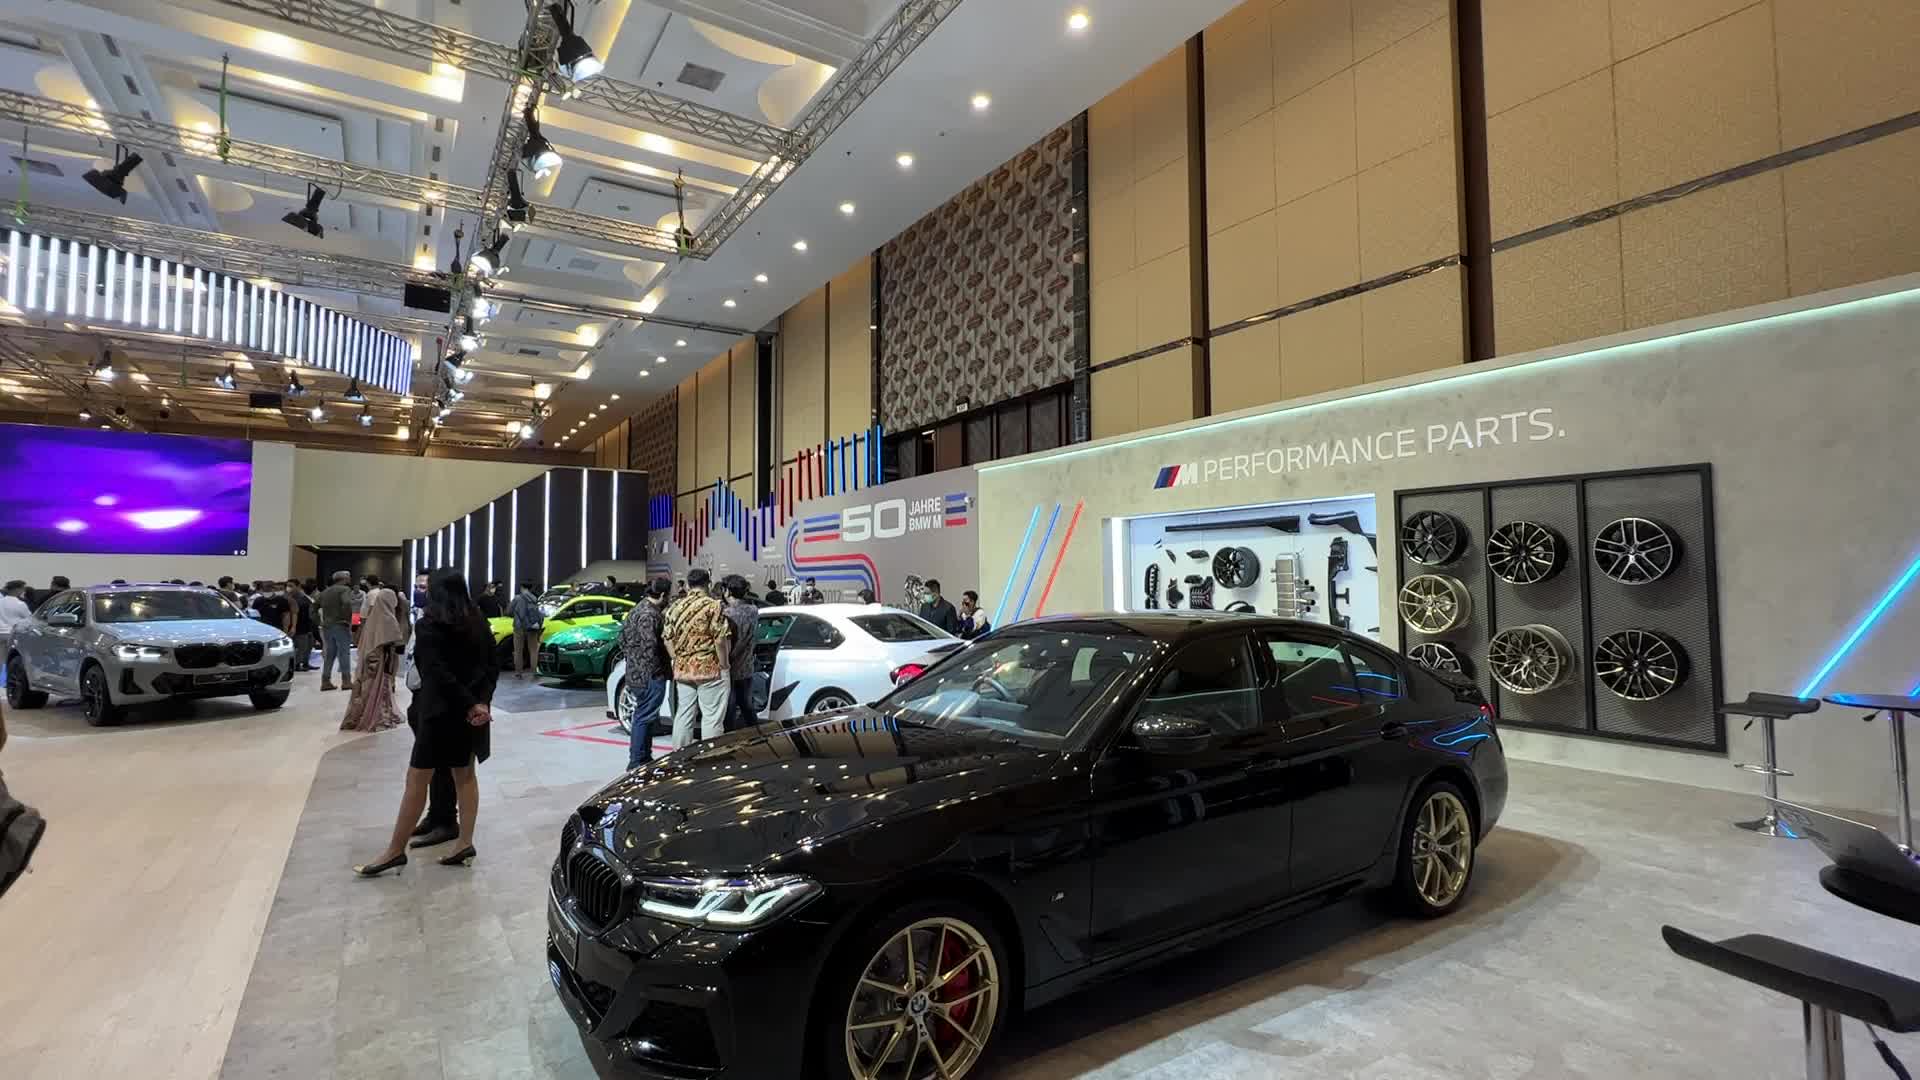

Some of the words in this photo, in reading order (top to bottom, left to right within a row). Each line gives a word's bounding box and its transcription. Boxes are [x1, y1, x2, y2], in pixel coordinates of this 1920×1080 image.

[1204, 428, 1417, 481] PERFORMANCE
[1427, 407, 1566, 454] PARTS.
[842, 499, 906, 542] 50
[908, 497, 941, 516] JAHRE
[908, 516, 933, 531] BMW
[933, 514, 942, 530] M
